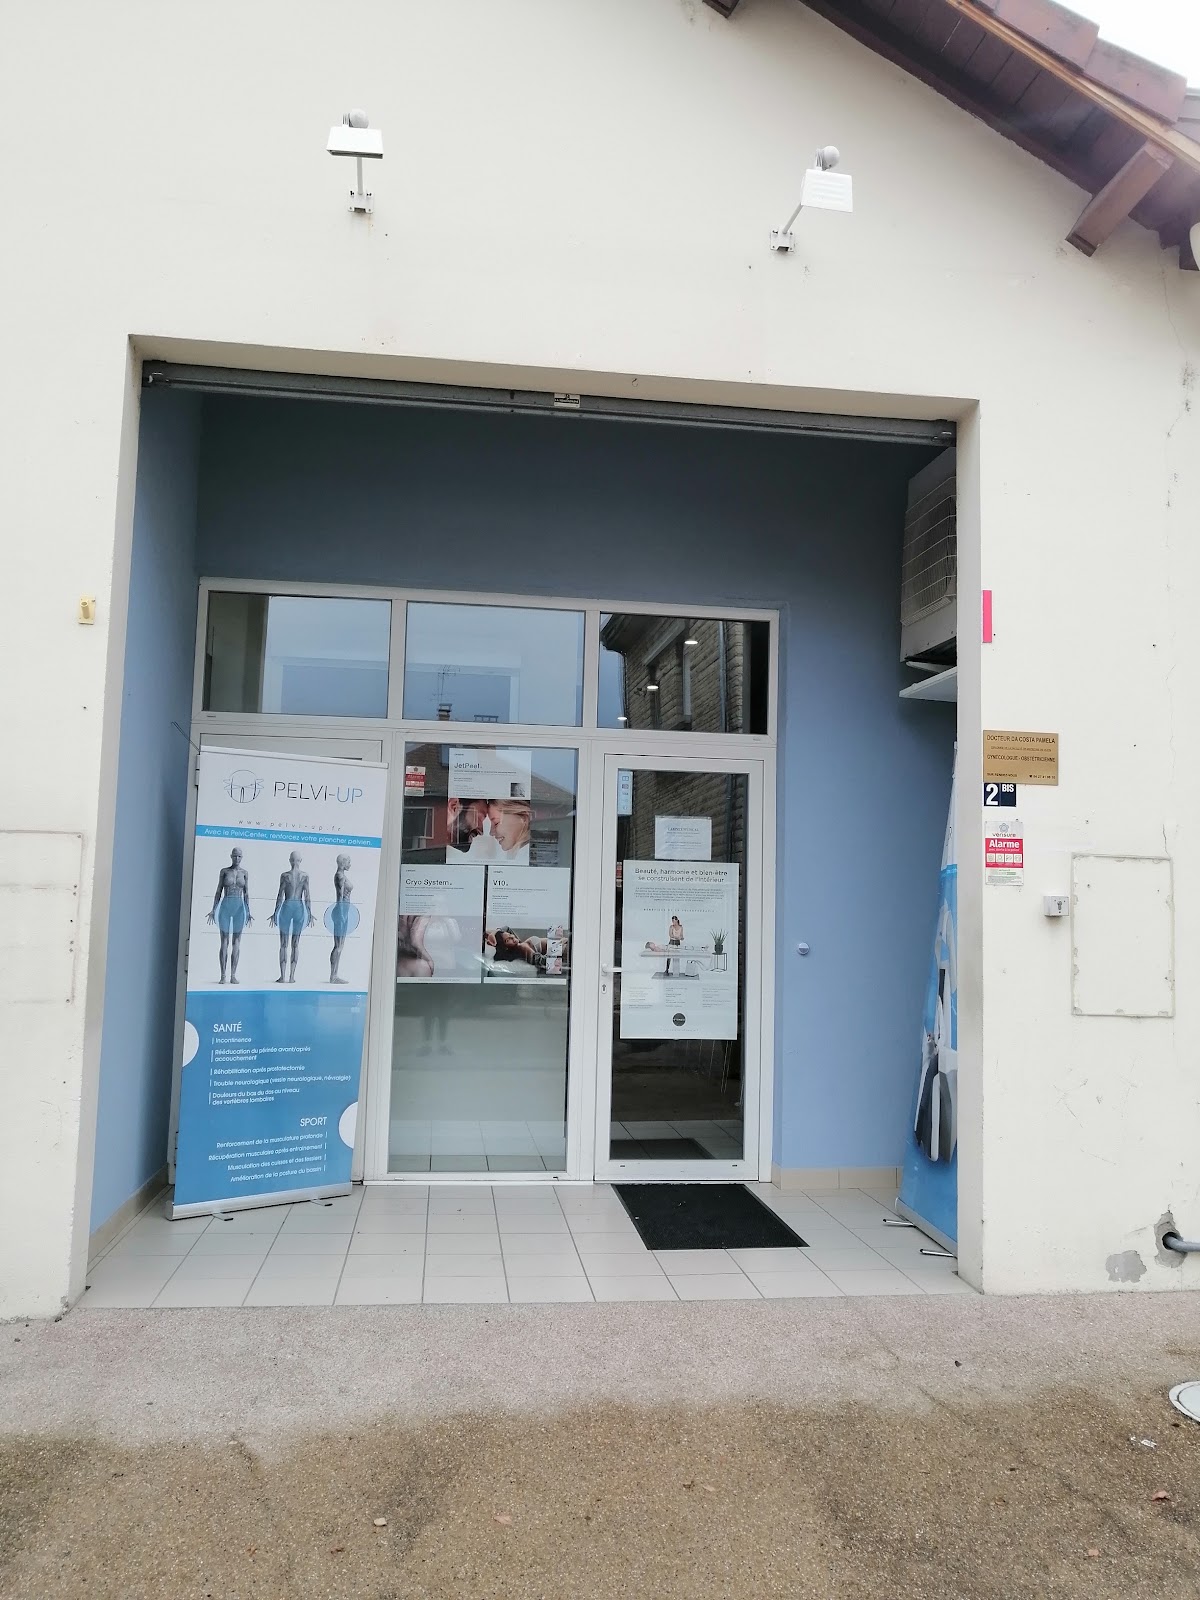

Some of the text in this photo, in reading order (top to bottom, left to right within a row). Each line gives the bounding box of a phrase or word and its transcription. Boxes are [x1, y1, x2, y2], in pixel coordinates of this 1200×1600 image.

[273, 781, 363, 803] PELVI-UP
[1002, 784, 1015, 793] BIS
[985, 783, 999, 806] 2
[270, 832, 300, 841] renforcez
[318, 836, 347, 844] plancher
[989, 839, 1020, 849] Alarme
[405, 878, 422, 886] Cryo
[213, 1021, 242, 1033] SANTÉ
[213, 1065, 305, 1075] Réhabilitation après prostatectomie
[234, 1078, 269, 1086] neurologique
[287, 1075, 323, 1083] neurologique,
[223, 1097, 249, 1105] vertèbres
[300, 1116, 327, 1127] SPORT
[216, 1140, 255, 1148] Renforcement
[270, 1135, 299, 1143] musculature
[208, 1152, 245, 1160] Récupération
[246, 1149, 274, 1157] musculaire
[227, 1162, 260, 1170] Musculation
[230, 1174, 264, 1182] Amélioration
[279, 1169, 297, 1177] posture
